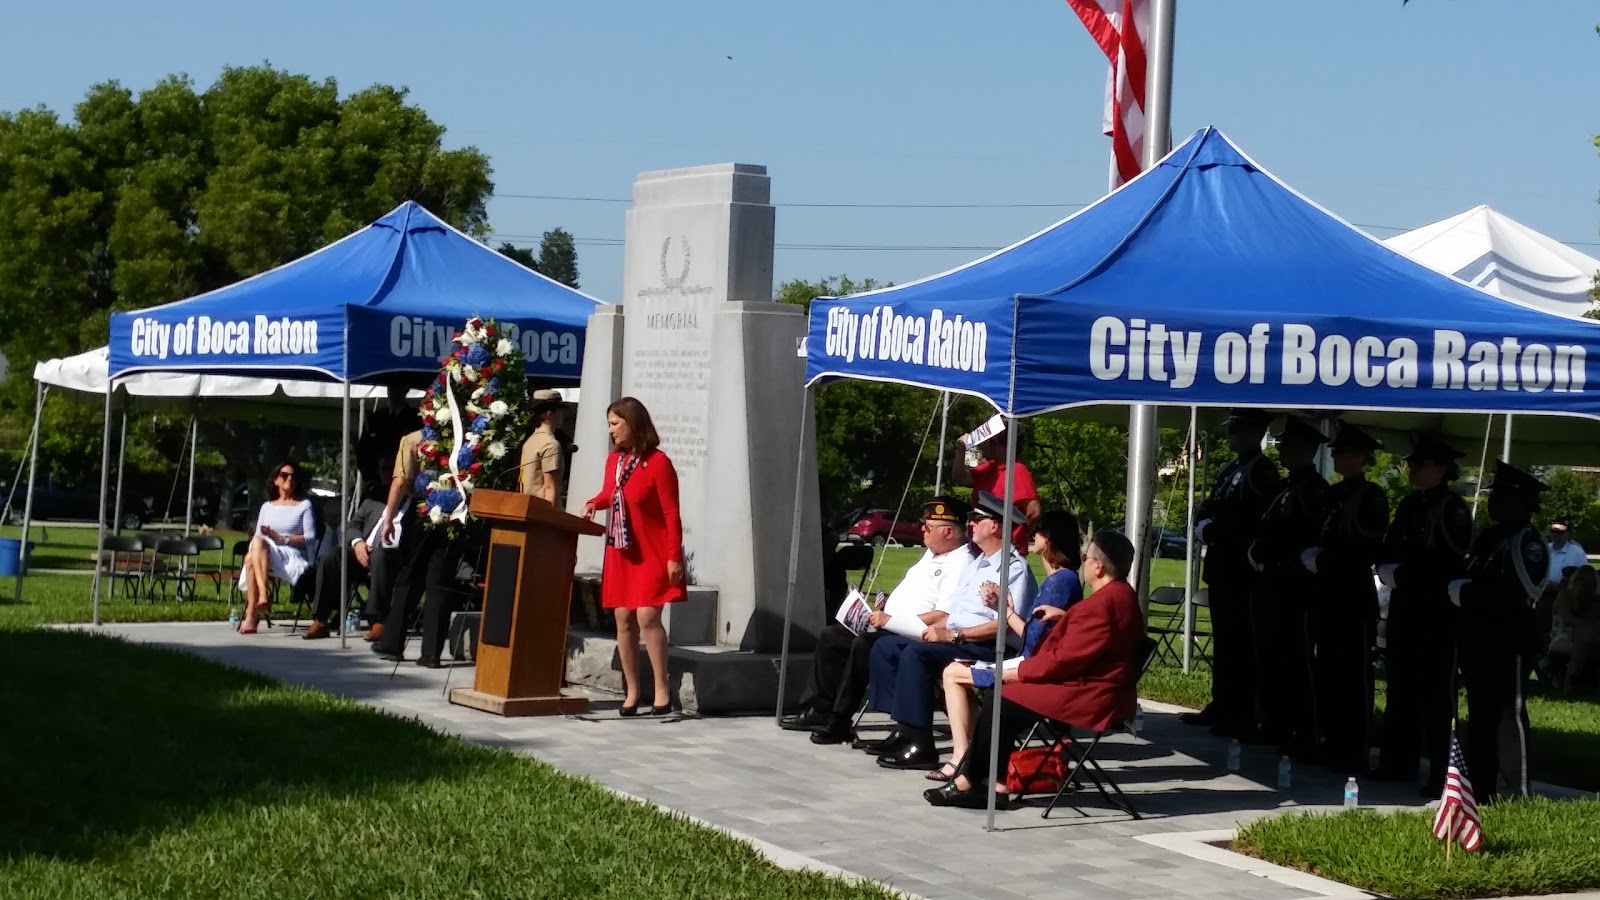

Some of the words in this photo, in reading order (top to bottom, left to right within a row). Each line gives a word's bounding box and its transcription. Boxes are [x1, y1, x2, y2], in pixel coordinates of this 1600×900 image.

[131, 317, 171, 359] City
[173, 316, 195, 356] of
[197, 315, 250, 355] Boca
[253, 314, 318, 355] Raton
[390, 315, 455, 362] City
[646, 312, 698, 330] MEMORIAL
[826, 307, 858, 363] City
[860, 306, 880, 358] of
[878, 306, 926, 364] Boca
[927, 308, 987, 373] Raton
[1089, 316, 1201, 389] City
[1213, 323, 1270, 384] of
[1281, 323, 1418, 388] Boca
[1431, 329, 1587, 393] Raton
